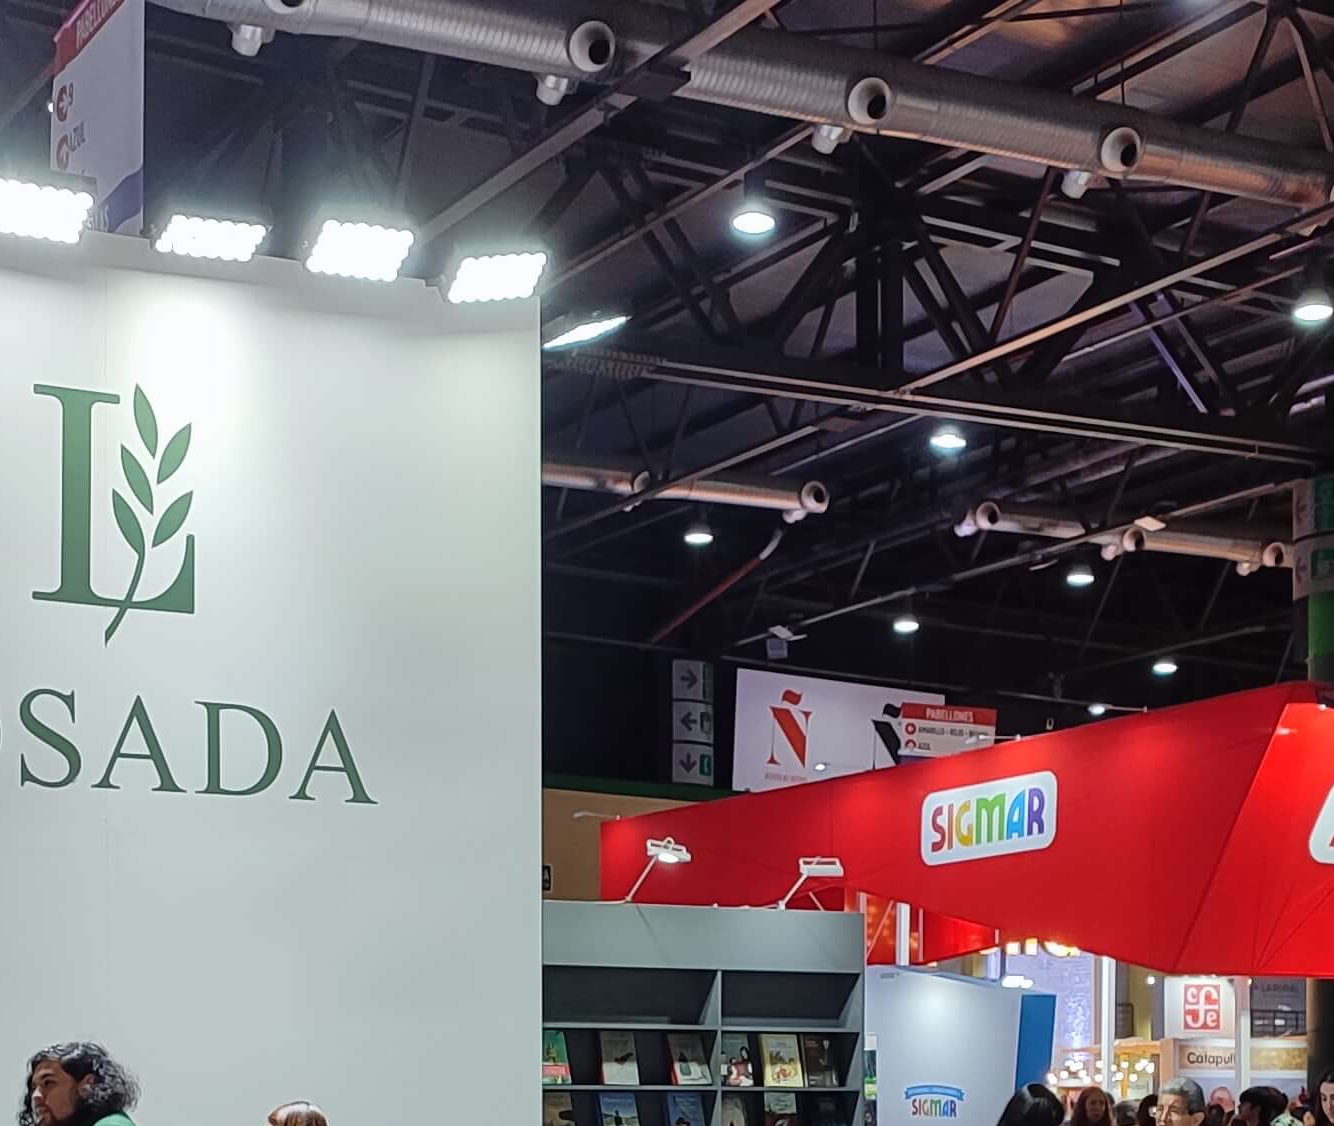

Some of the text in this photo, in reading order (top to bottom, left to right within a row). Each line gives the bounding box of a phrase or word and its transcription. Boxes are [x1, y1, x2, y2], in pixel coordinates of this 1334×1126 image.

[767, 688, 812, 769] Ñ
[925, 707, 974, 722] PABELLONES
[931, 787, 1046, 853] SIGMAR
[912, 1098, 957, 1118] SIGMAR
